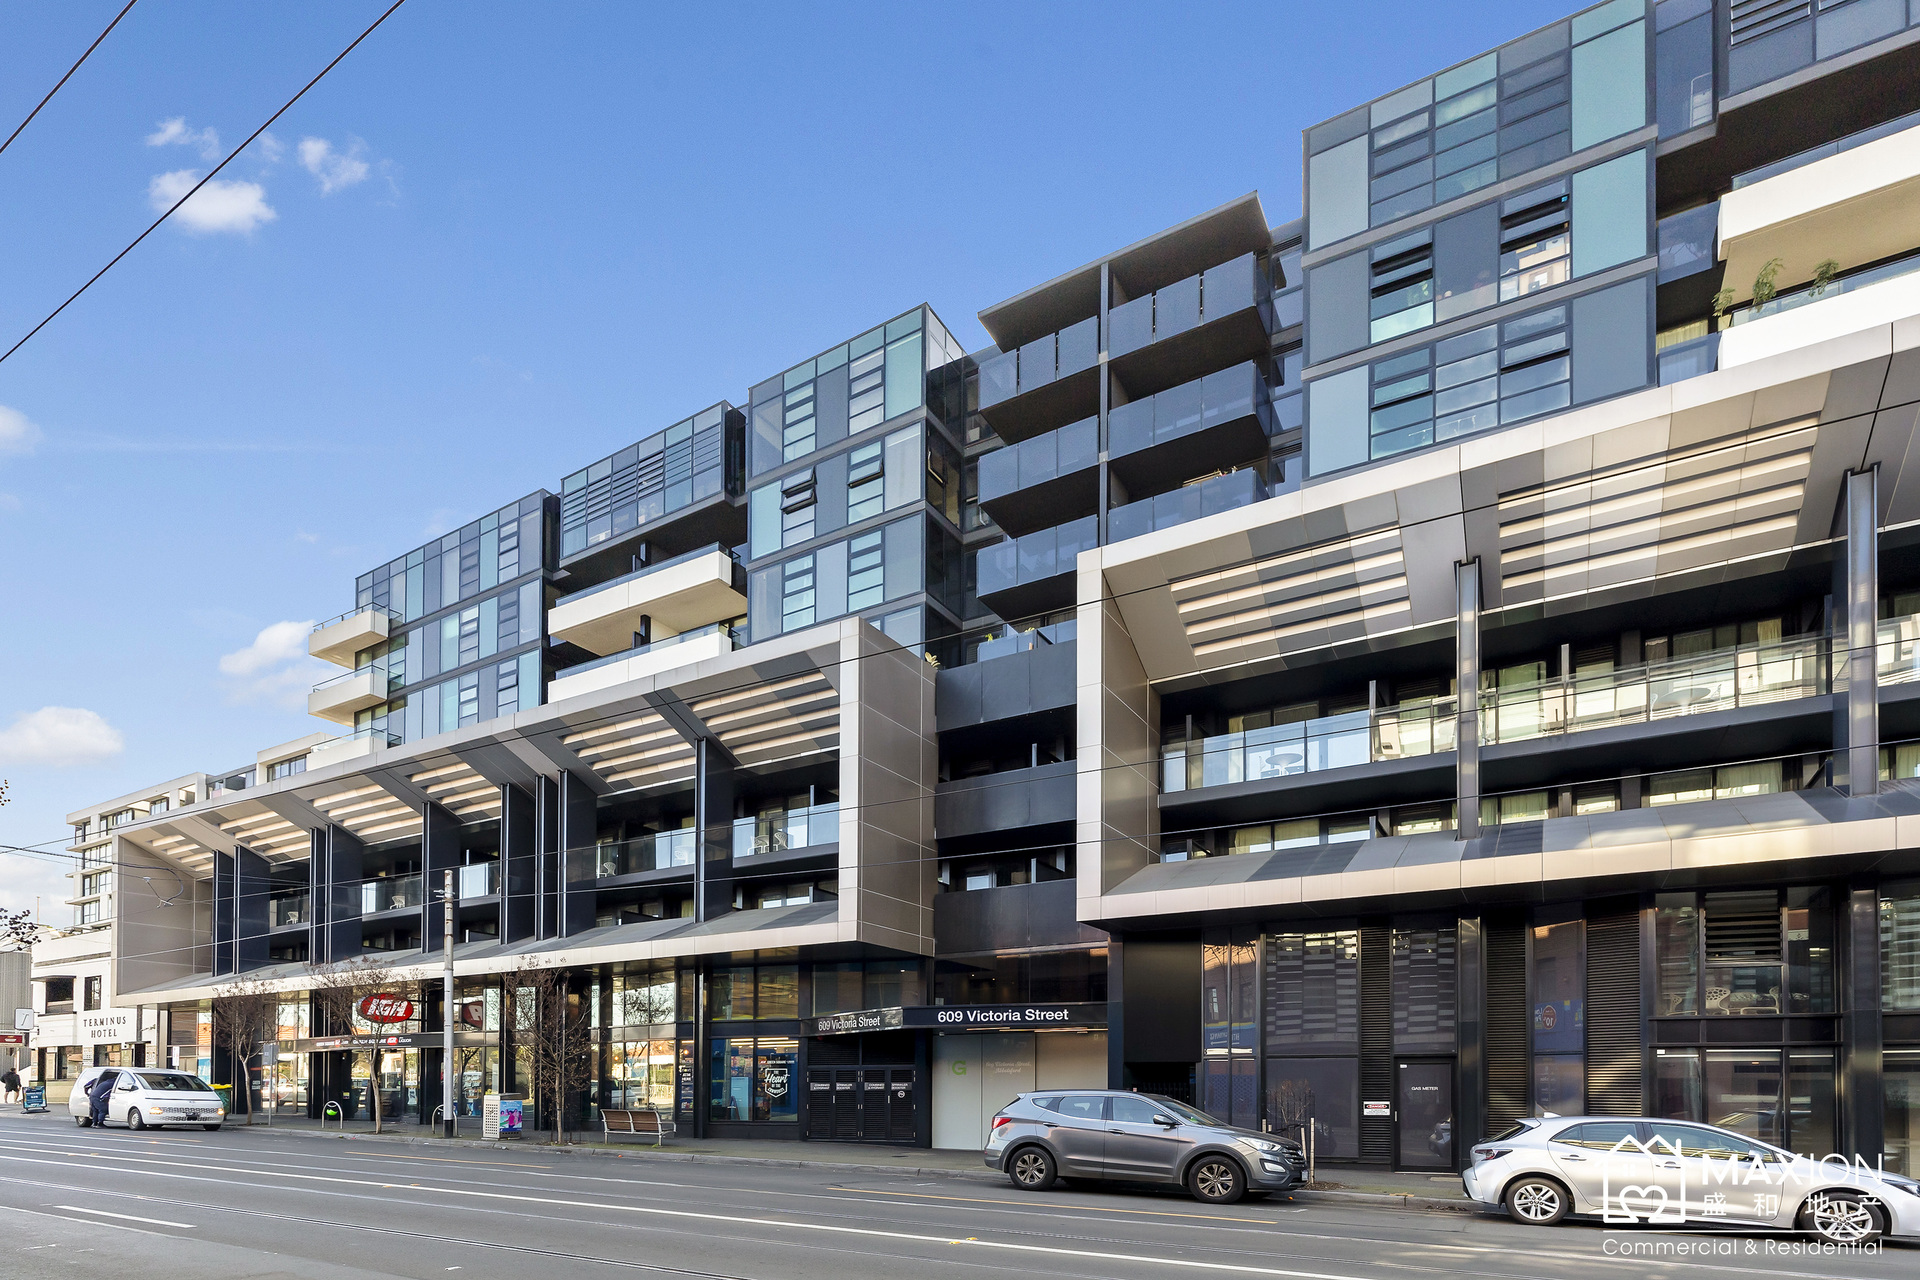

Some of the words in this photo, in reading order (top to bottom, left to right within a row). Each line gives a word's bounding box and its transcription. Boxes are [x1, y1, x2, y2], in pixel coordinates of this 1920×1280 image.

[367, 998, 408, 1017] IGA
[83, 1016, 127, 1027] TERMINUS
[938, 1011, 963, 1022] 609
[966, 1009, 1021, 1021] Victoria
[1025, 1009, 1069, 1020] Street
[818, 1021, 830, 1031] 609
[831, 1017, 857, 1030] Victoria
[858, 1016, 880, 1028] Street
[91, 1028, 118, 1039] HOTEL
[764, 1073, 790, 1083] Heart
